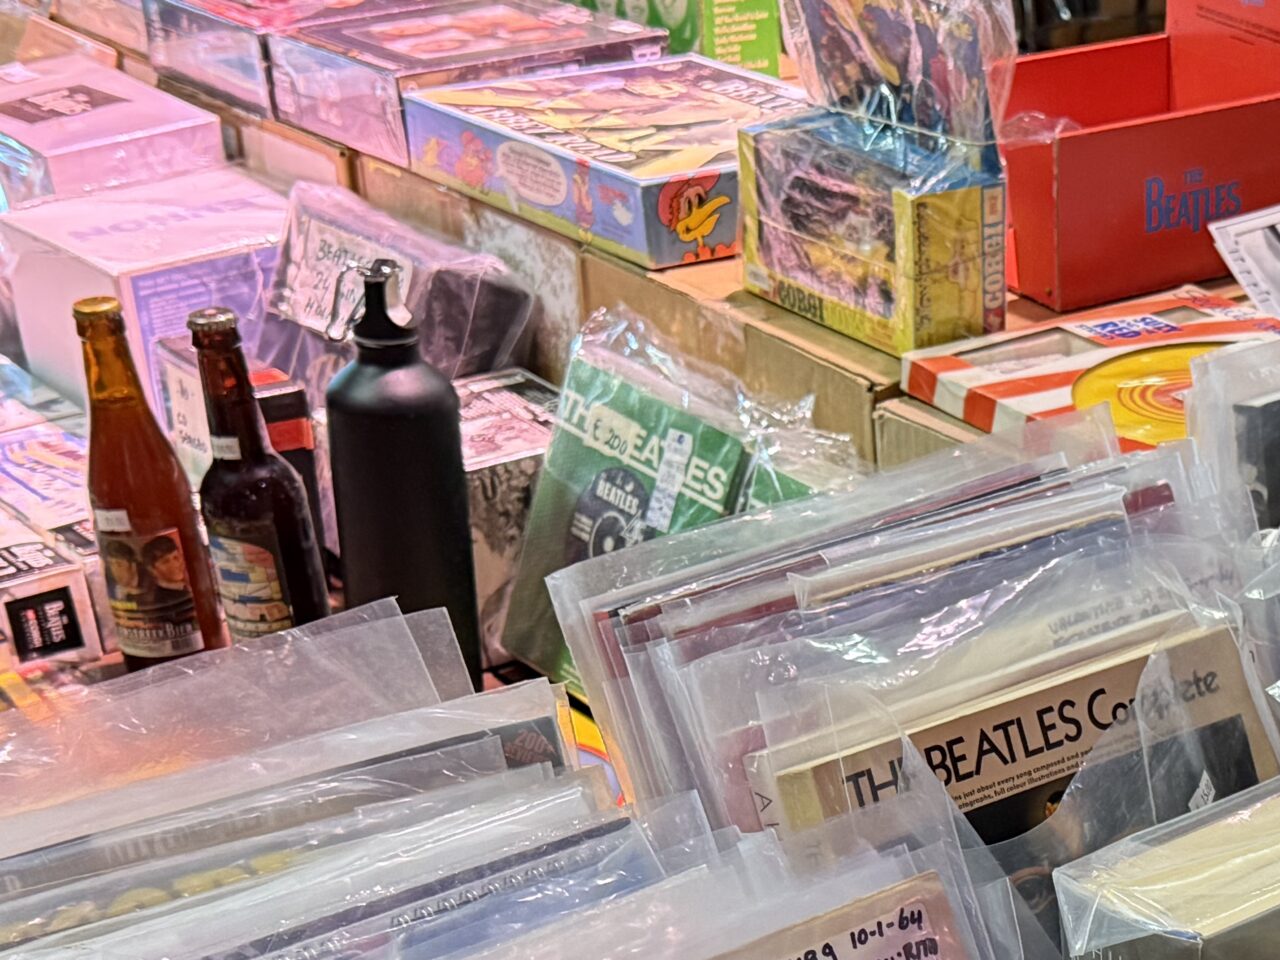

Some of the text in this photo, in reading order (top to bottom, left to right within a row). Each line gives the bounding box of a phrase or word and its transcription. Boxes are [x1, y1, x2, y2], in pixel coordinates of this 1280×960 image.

[1183, 167, 1204, 184] THE
[1145, 176, 1242, 234] BEATLES
[984, 222, 1006, 310] CORGI
[595, 479, 640, 516] BEATLES
[923, 698, 1083, 788] BEATLES
[976, 781, 997, 795] about
[997, 775, 1016, 788] every
[1016, 769, 1033, 782] song
[849, 907, 924, 950] 10-1-64
